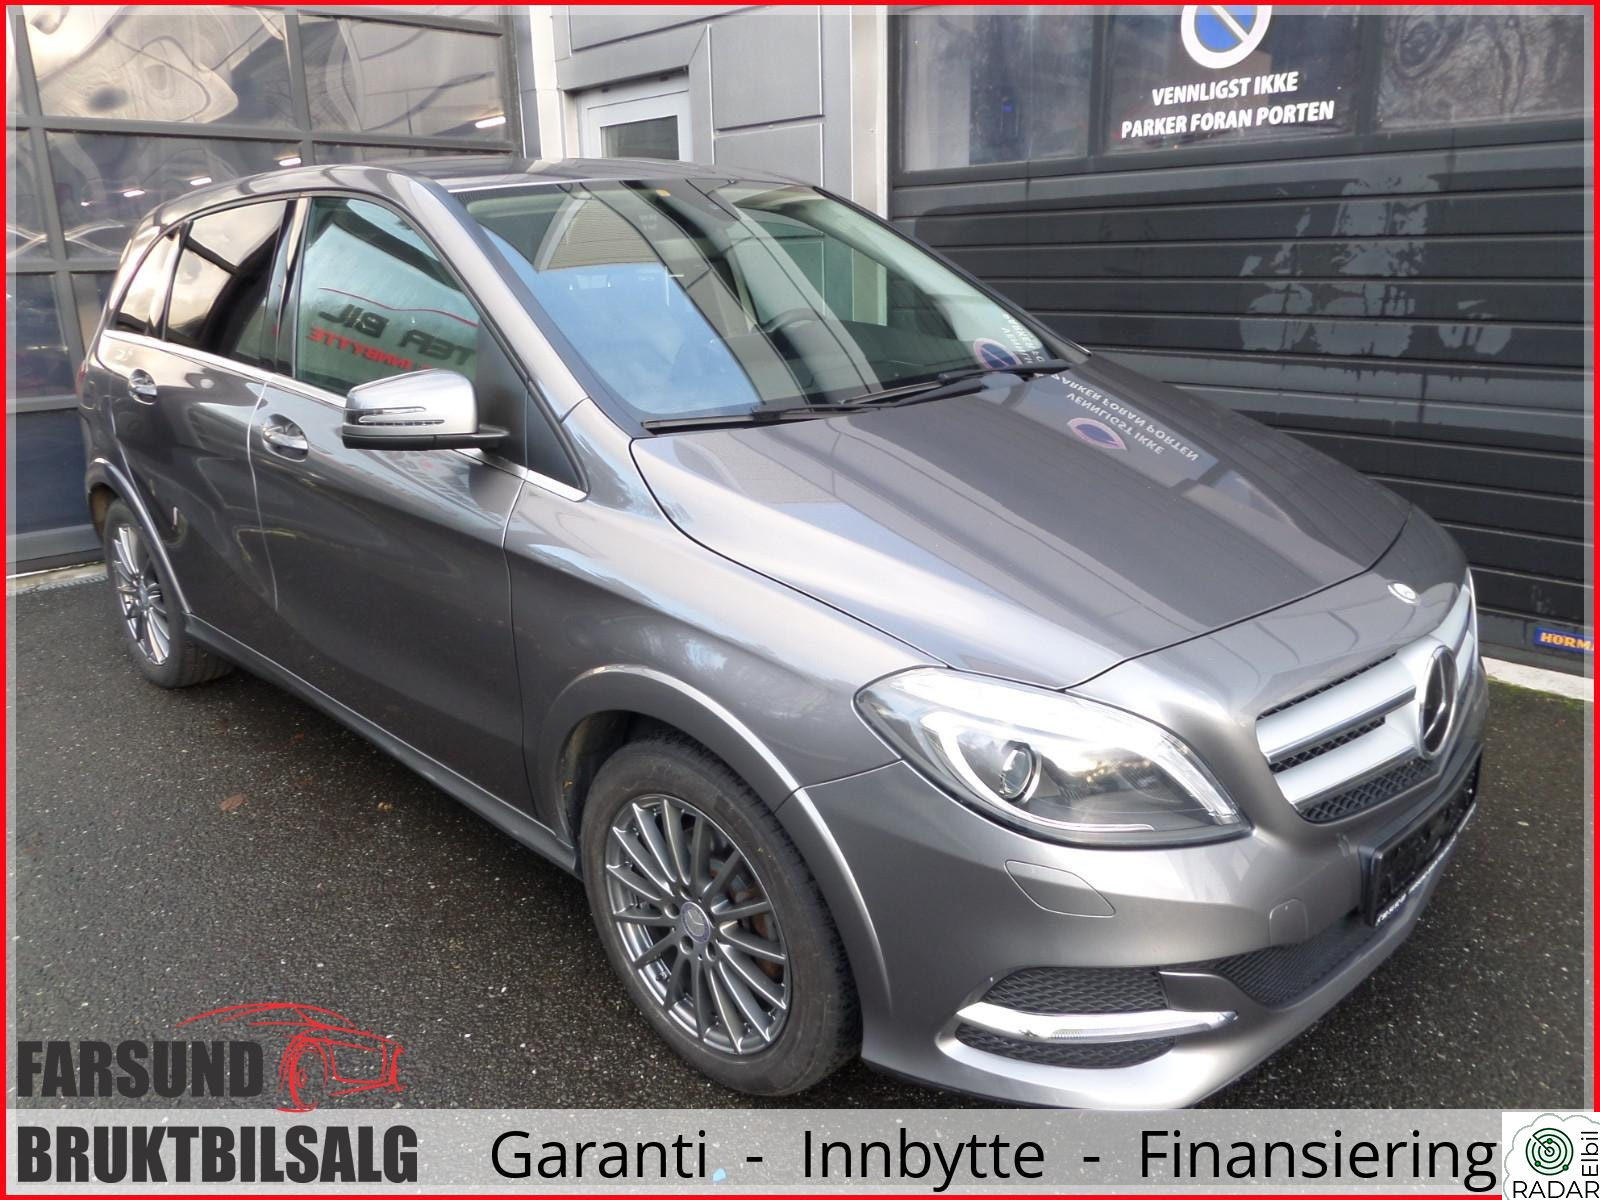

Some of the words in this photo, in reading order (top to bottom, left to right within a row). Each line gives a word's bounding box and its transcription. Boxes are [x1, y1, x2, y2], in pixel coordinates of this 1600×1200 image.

[1152, 77, 1251, 106] VENNLIGST
[1254, 71, 1299, 96] IKKE
[1121, 115, 1187, 139] PARKER
[1190, 109, 1253, 132] FORAN
[1256, 100, 1335, 126] PORTEN
